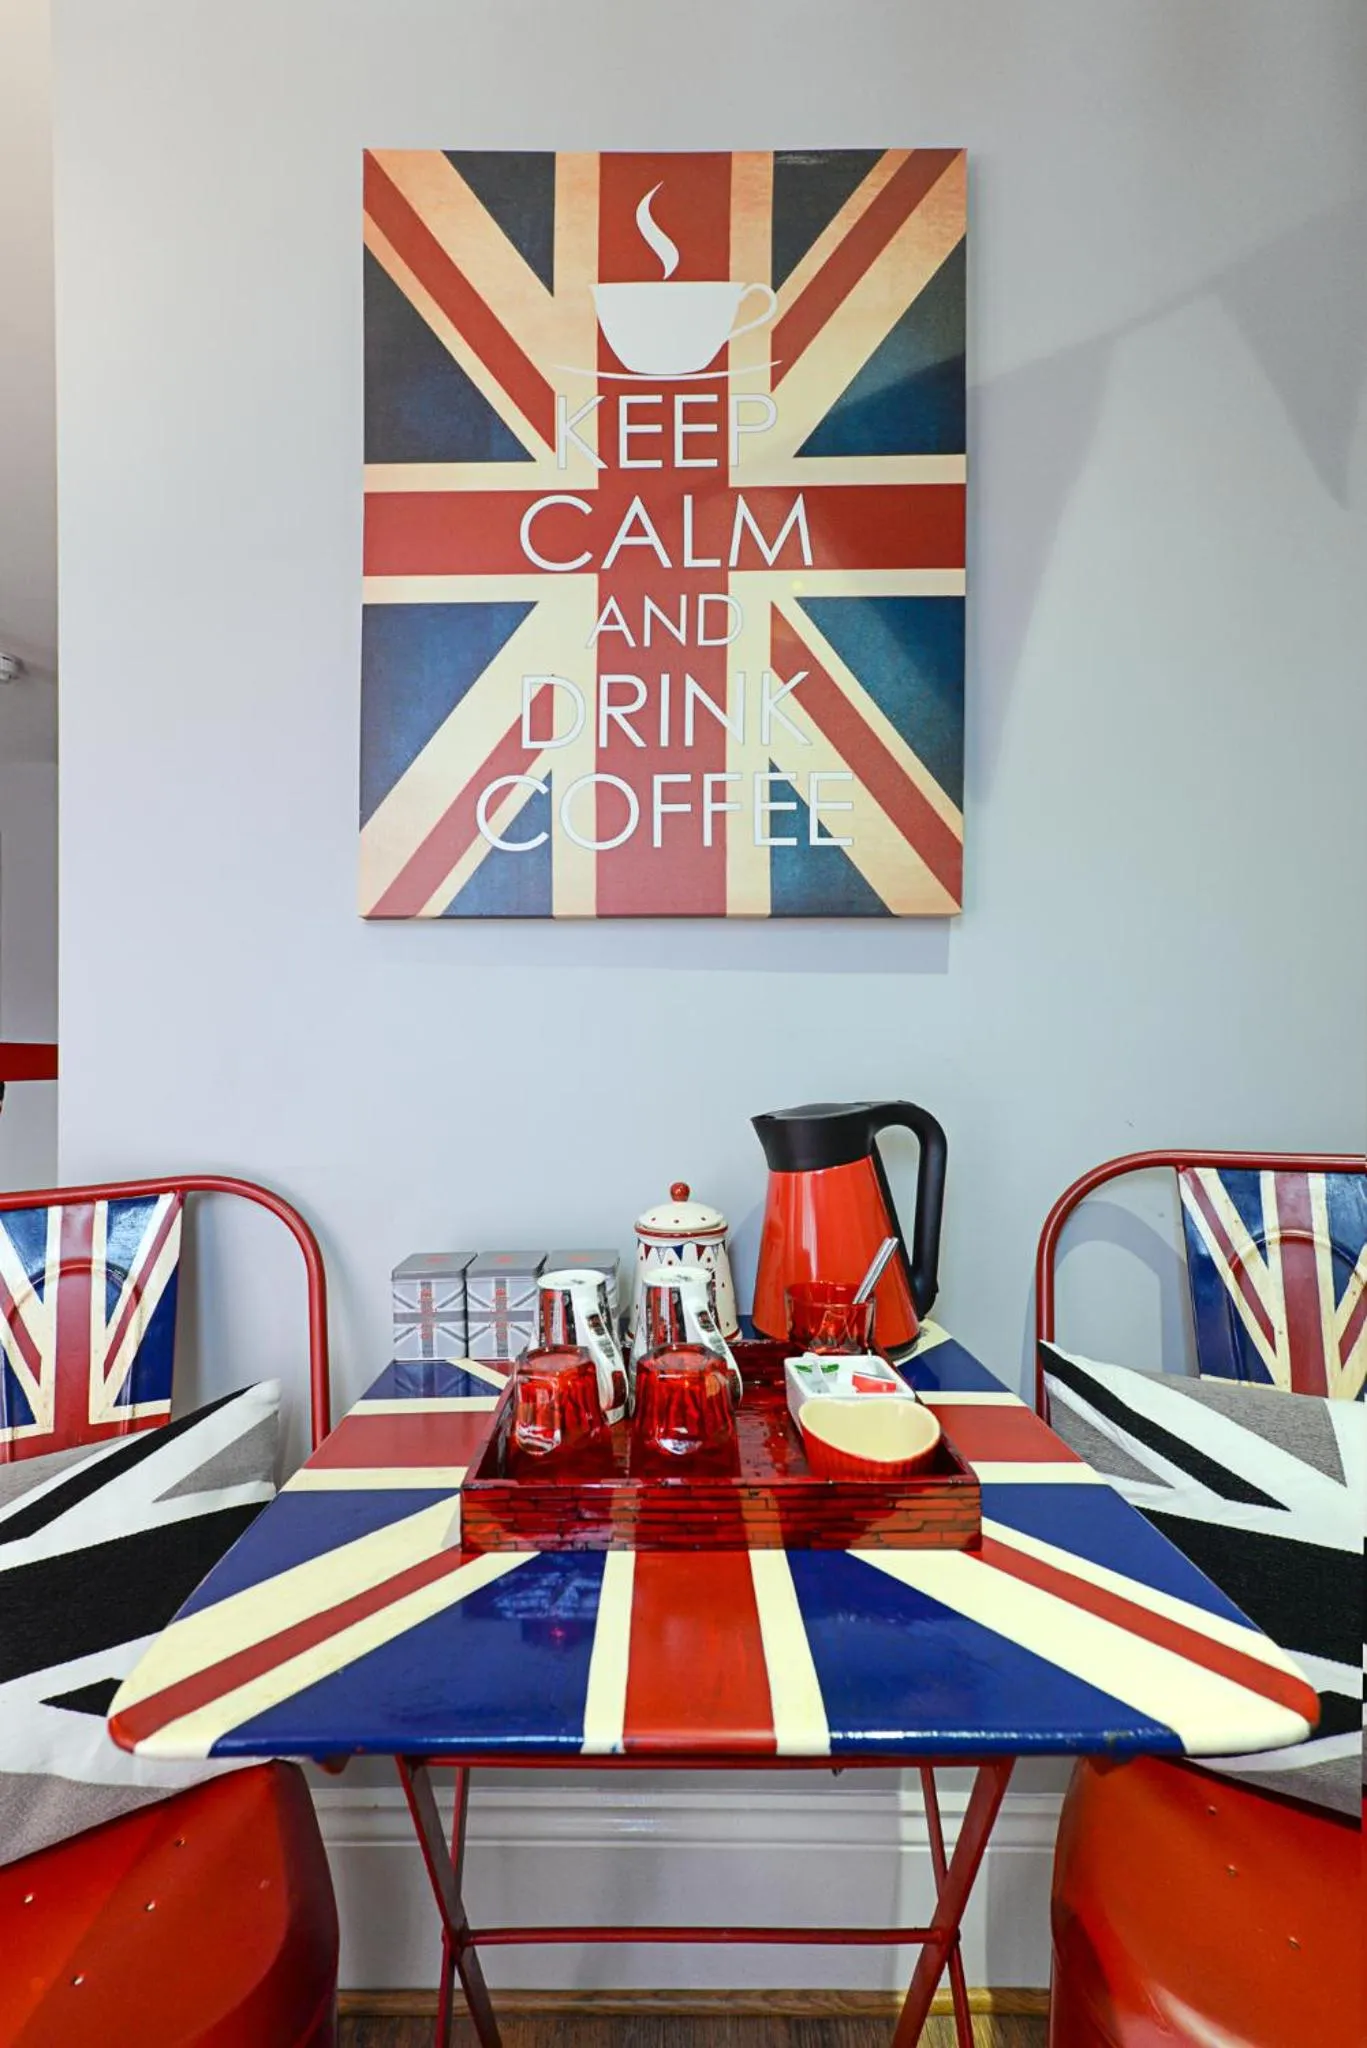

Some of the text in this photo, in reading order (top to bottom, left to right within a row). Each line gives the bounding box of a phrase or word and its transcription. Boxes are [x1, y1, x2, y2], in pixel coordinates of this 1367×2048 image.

[556, 394, 777, 470] KEEP
[520, 493, 813, 571] CALM
[586, 594, 744, 648] AND
[521, 672, 812, 749] DRINK
[476, 772, 854, 851] COFFEE
